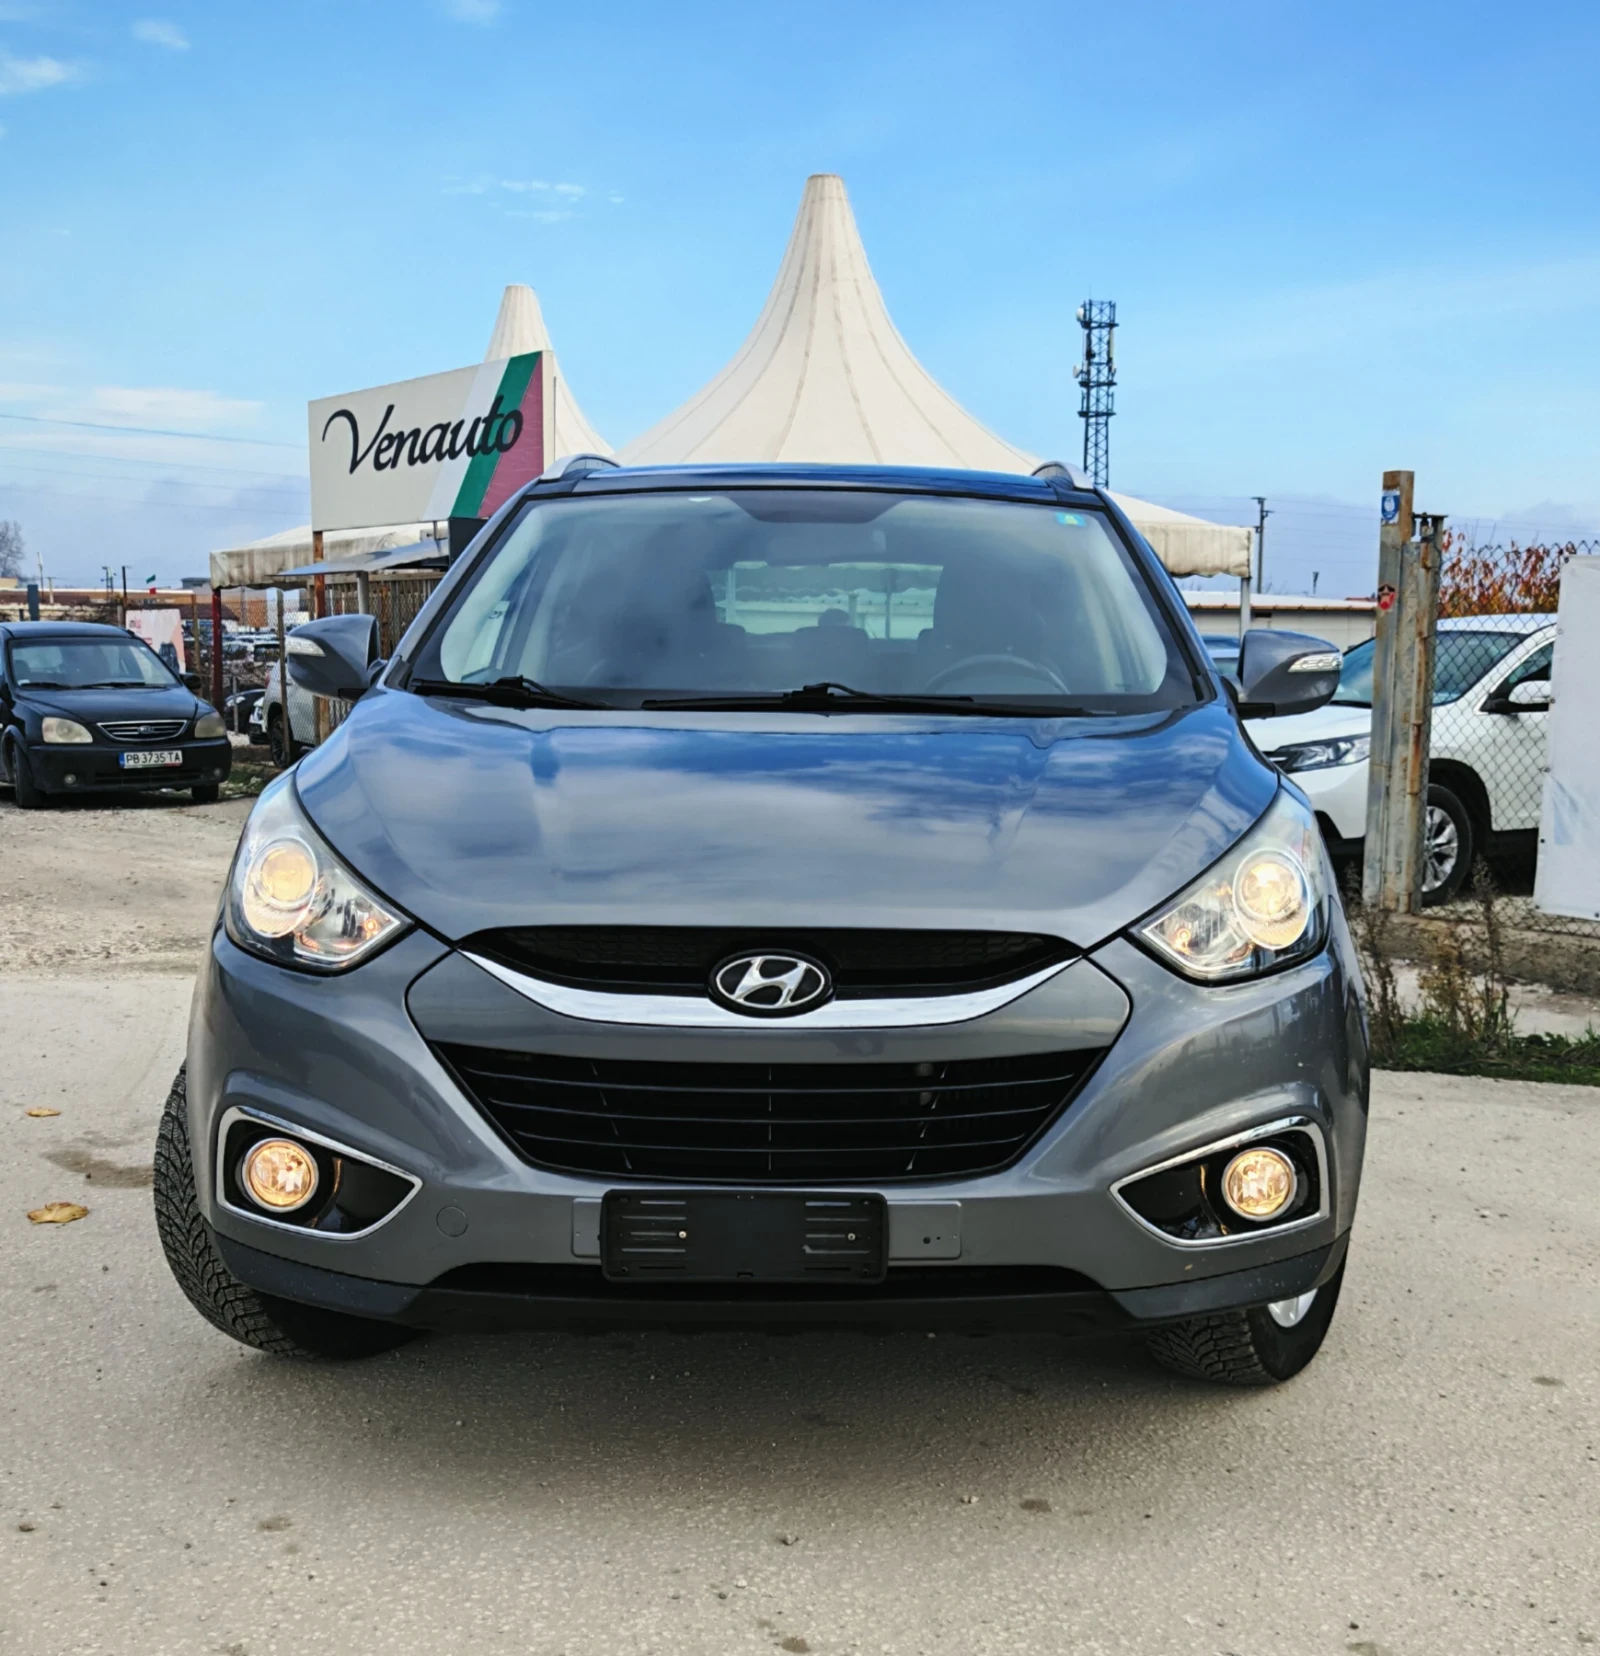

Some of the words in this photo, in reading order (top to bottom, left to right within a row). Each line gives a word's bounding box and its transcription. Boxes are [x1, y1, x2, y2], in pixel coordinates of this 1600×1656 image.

[322, 395, 524, 475] Venauto
[126, 754, 140, 764] PB
[141, 752, 166, 764] 3735
[168, 752, 181, 762] TA
